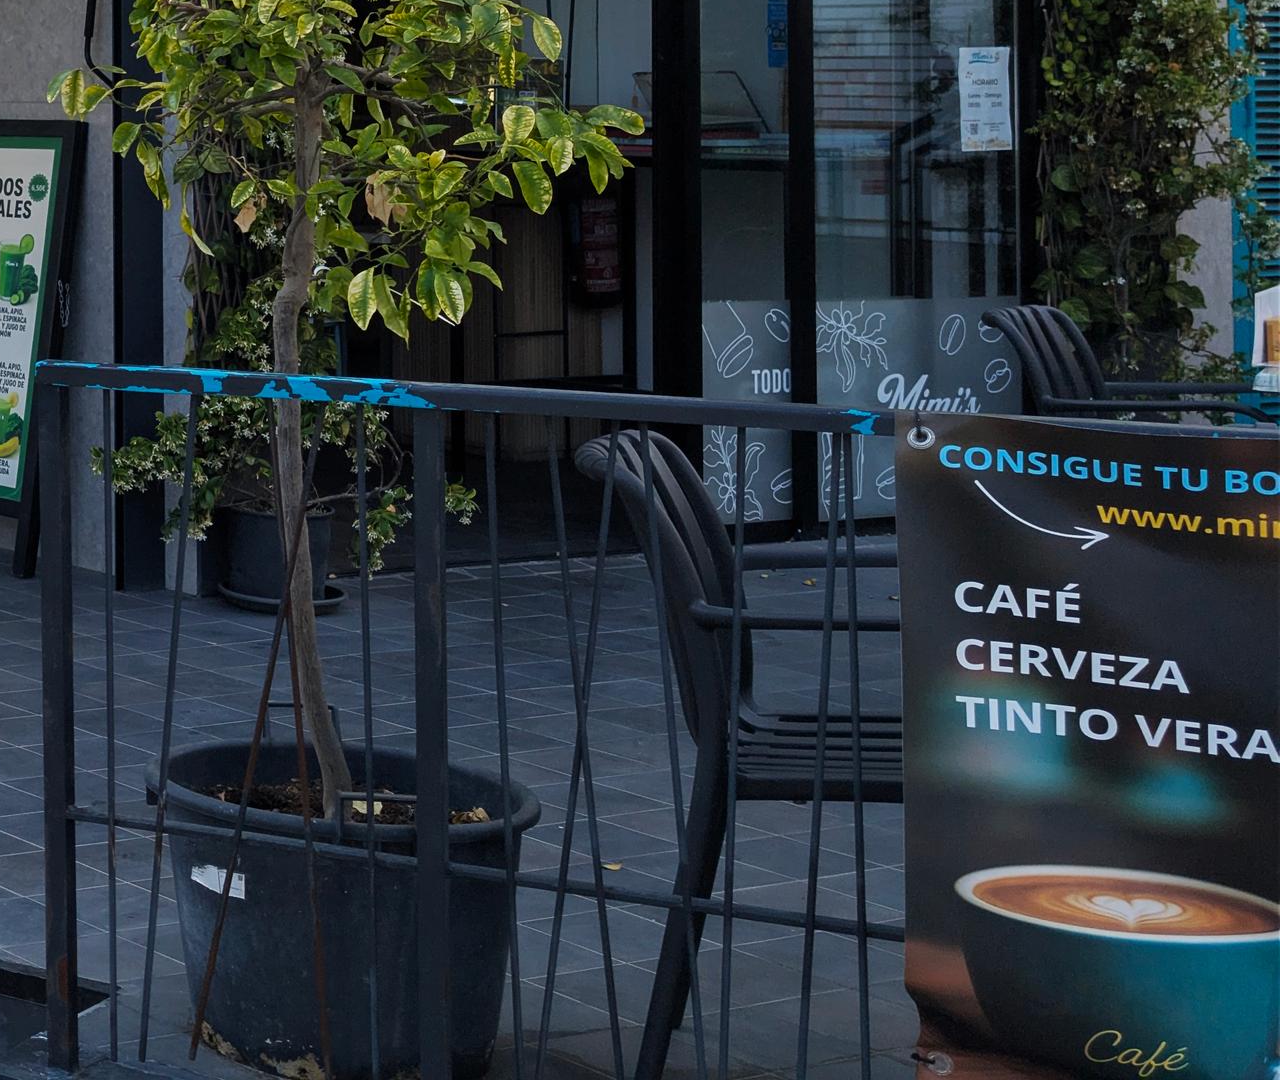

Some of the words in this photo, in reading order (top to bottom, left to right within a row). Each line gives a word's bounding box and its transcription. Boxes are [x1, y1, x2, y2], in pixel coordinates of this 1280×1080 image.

[3, 314, 27, 324] ESPINACA
[5, 323, 19, 331] JUGO
[19, 324, 26, 332] DE
[0, 369, 26, 380] ESPINACA
[2, 379, 16, 387] JUGO
[17, 380, 25, 388] DE
[877, 373, 981, 414] Mimi's
[939, 444, 1143, 487] CONSIGUE
[1154, 465, 1209, 493] TU
[1224, 470, 1280, 496] BO
[954, 580, 1082, 624] CAFÉ
[955, 637, 1191, 695] CERVEZA
[955, 695, 1119, 742] TINTO
[1134, 714, 1280, 764] VERA
[1084, 1029, 1190, 1078] Café
